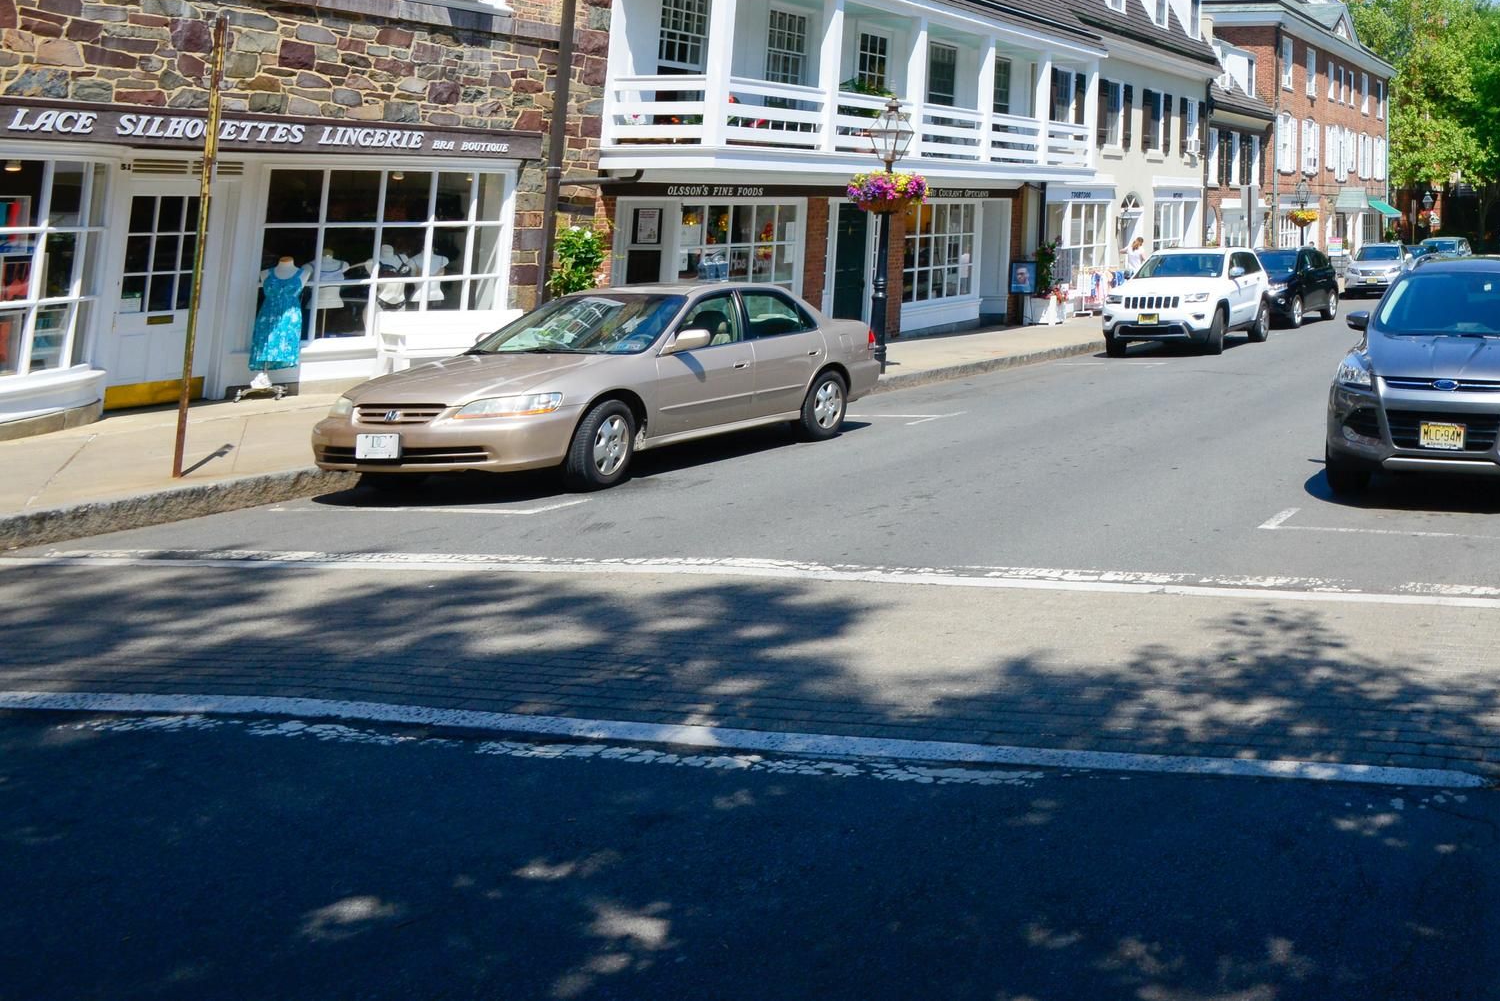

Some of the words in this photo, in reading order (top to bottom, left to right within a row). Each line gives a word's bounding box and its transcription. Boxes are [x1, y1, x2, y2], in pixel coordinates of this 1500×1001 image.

[8, 108, 98, 134] LACE
[317, 126, 425, 149] LINGERIE
[432, 140, 455, 150] BRA
[461, 141, 510, 153] BOUTIQUE
[667, 185, 709, 196] OLSSON'S
[712, 186, 734, 196] FINE
[737, 187, 764, 196] FOODS
